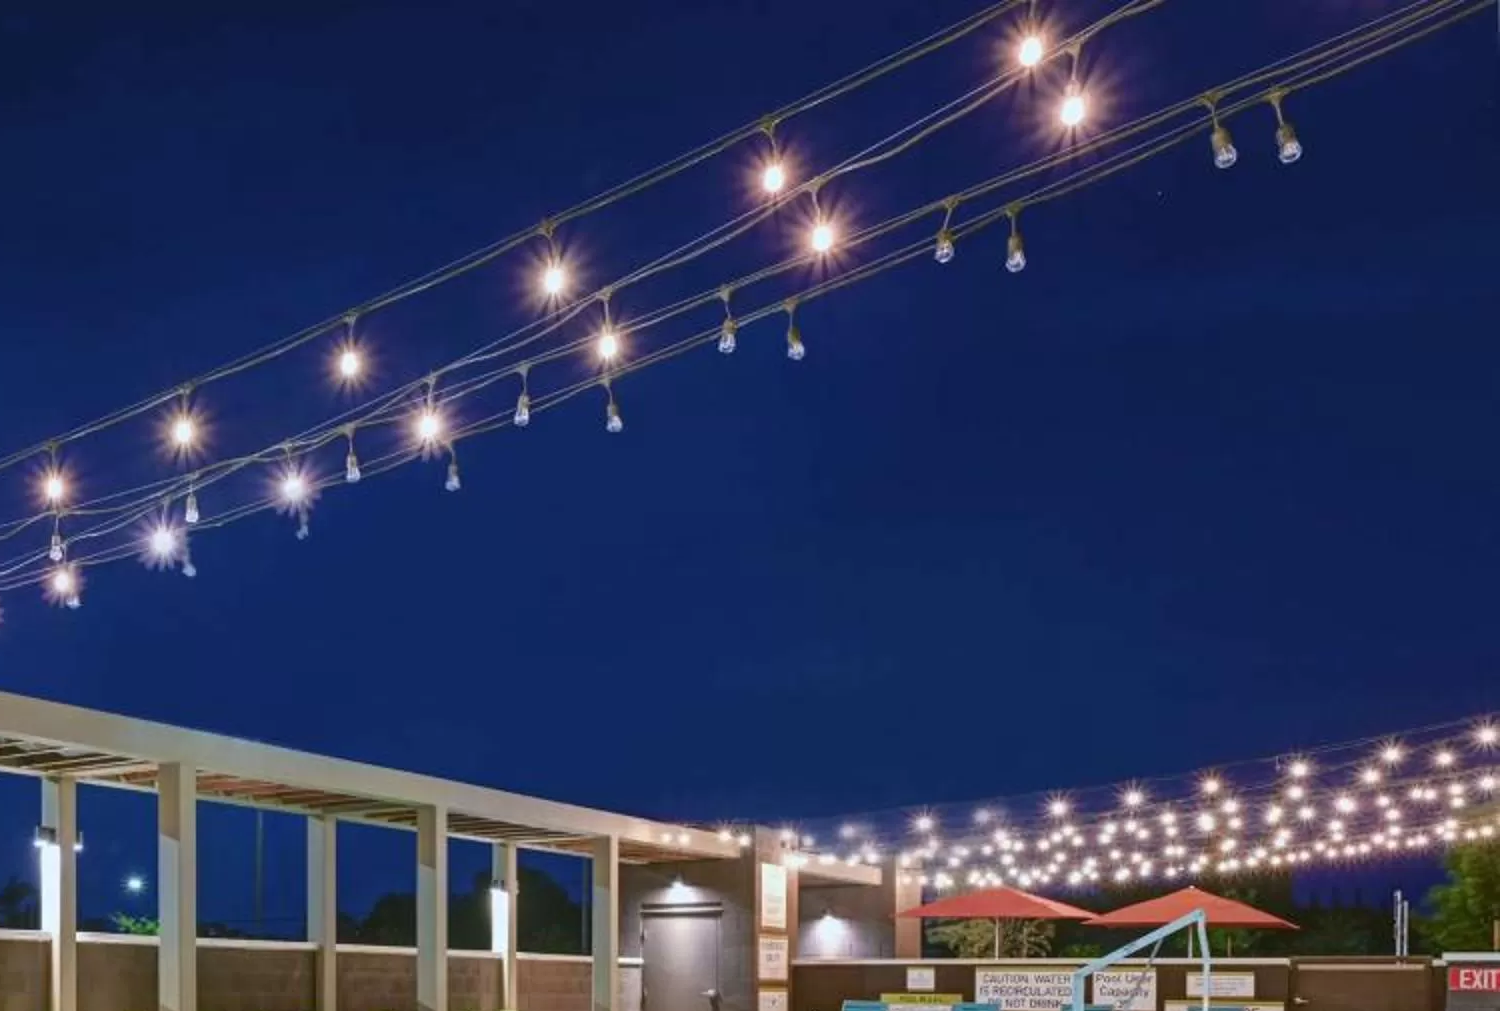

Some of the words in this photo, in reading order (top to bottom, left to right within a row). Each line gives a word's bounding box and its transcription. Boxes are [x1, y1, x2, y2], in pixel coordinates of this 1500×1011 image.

[1034, 973, 1071, 984] WATER
[1460, 969, 1500, 989] EXIT
[992, 985, 1073, 997] RECIRCULATED
[1005, 997, 1026, 1009] NOT
[1030, 997, 1063, 1009] DRINK
